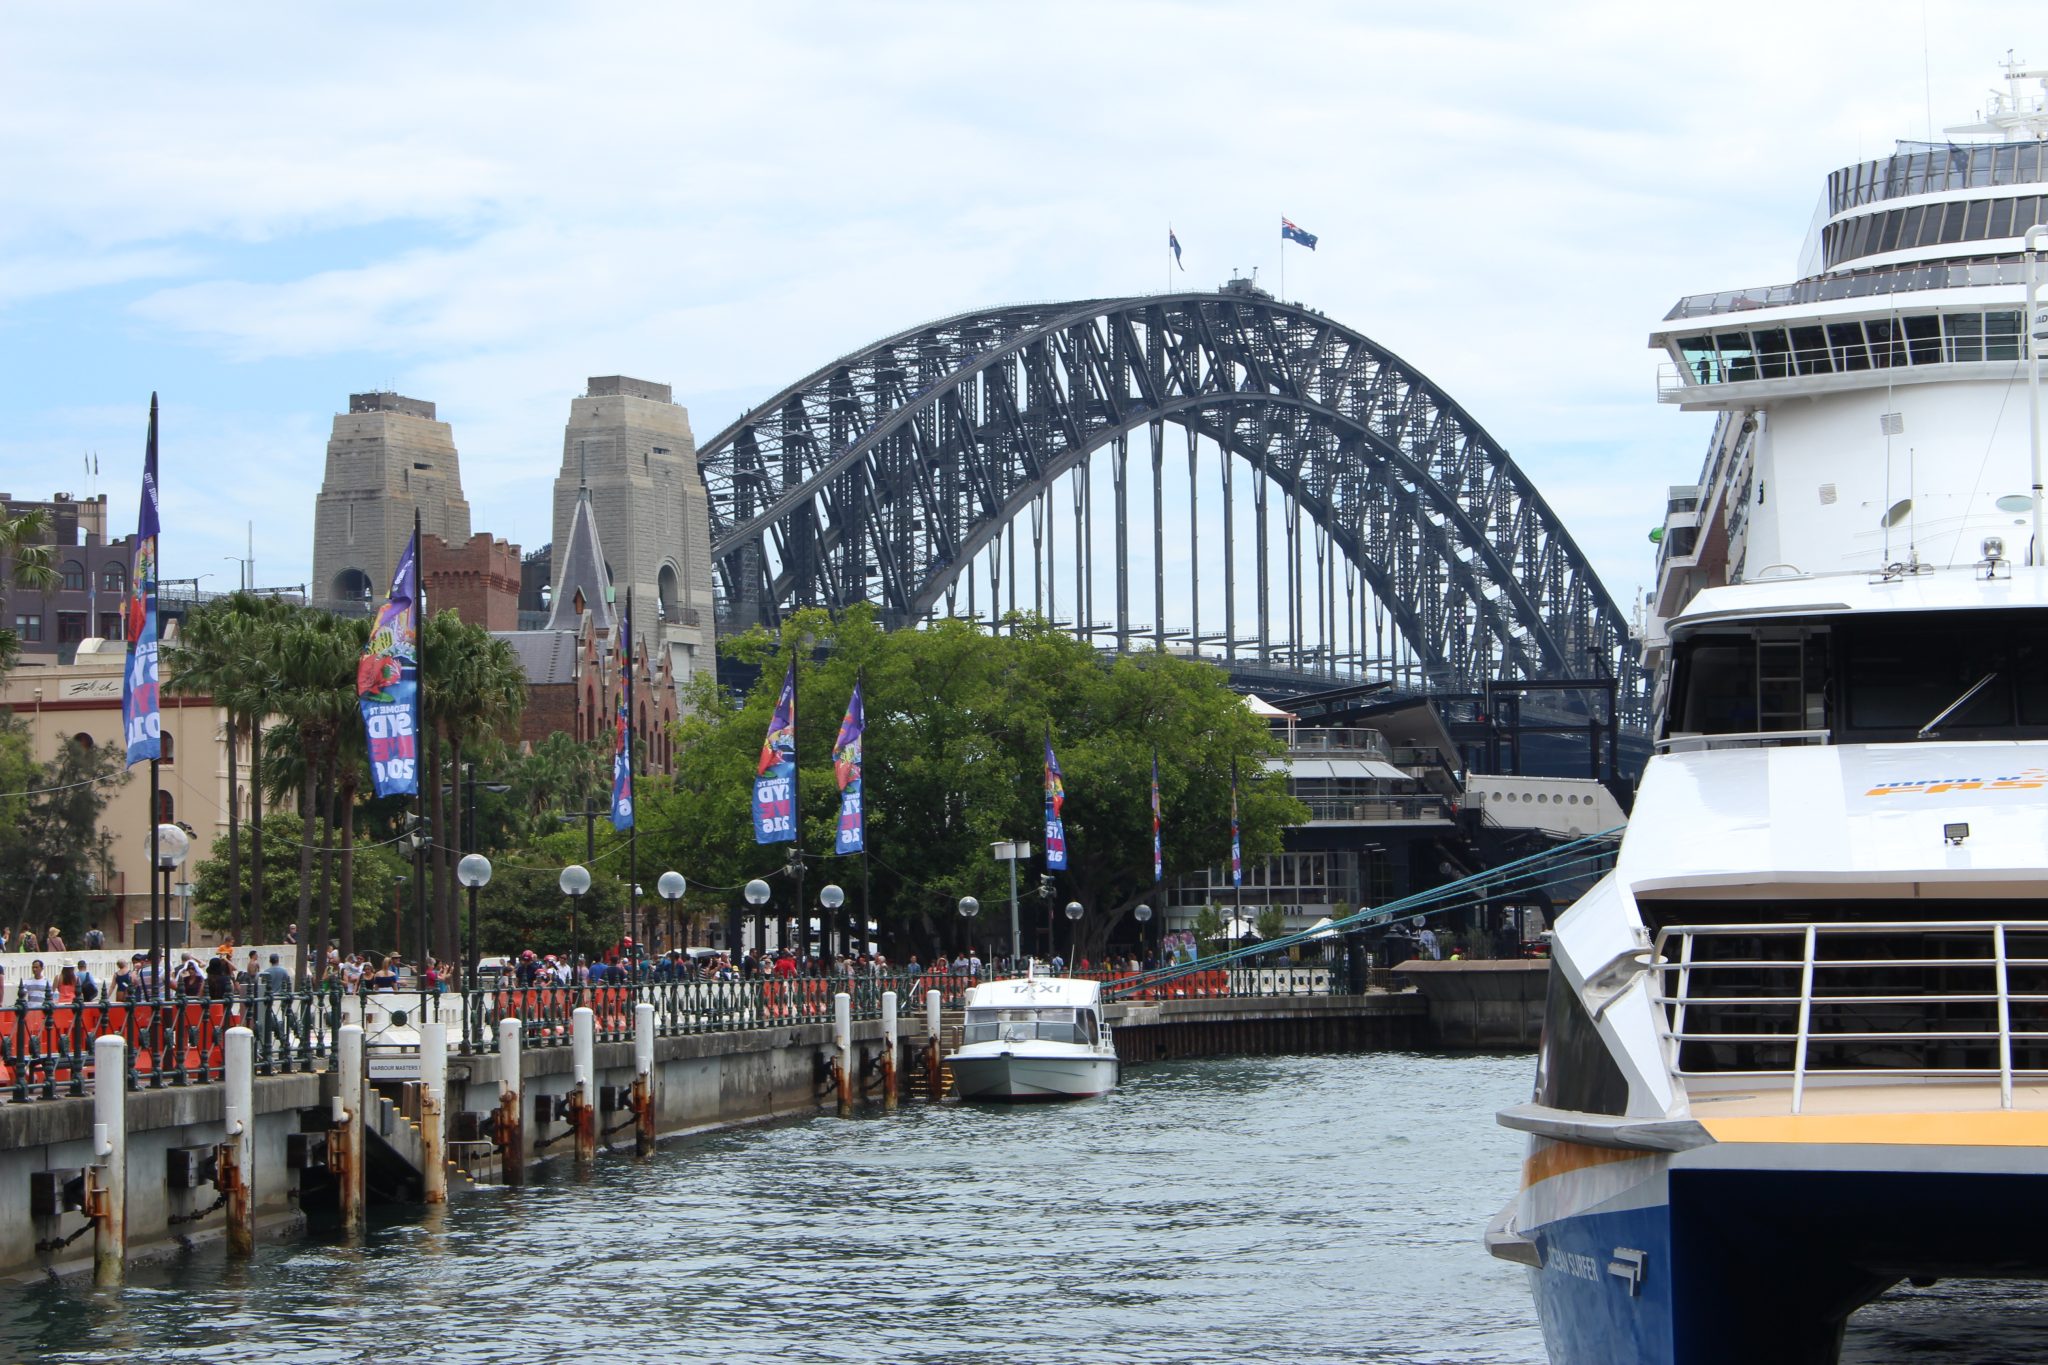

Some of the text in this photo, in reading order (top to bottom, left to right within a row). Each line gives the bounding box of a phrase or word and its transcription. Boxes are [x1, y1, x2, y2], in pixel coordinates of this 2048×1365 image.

[1283, 905, 1303, 916] BAR
[1010, 985, 1061, 993] TAXI
[1568, 1252, 1600, 1282] SURFER
